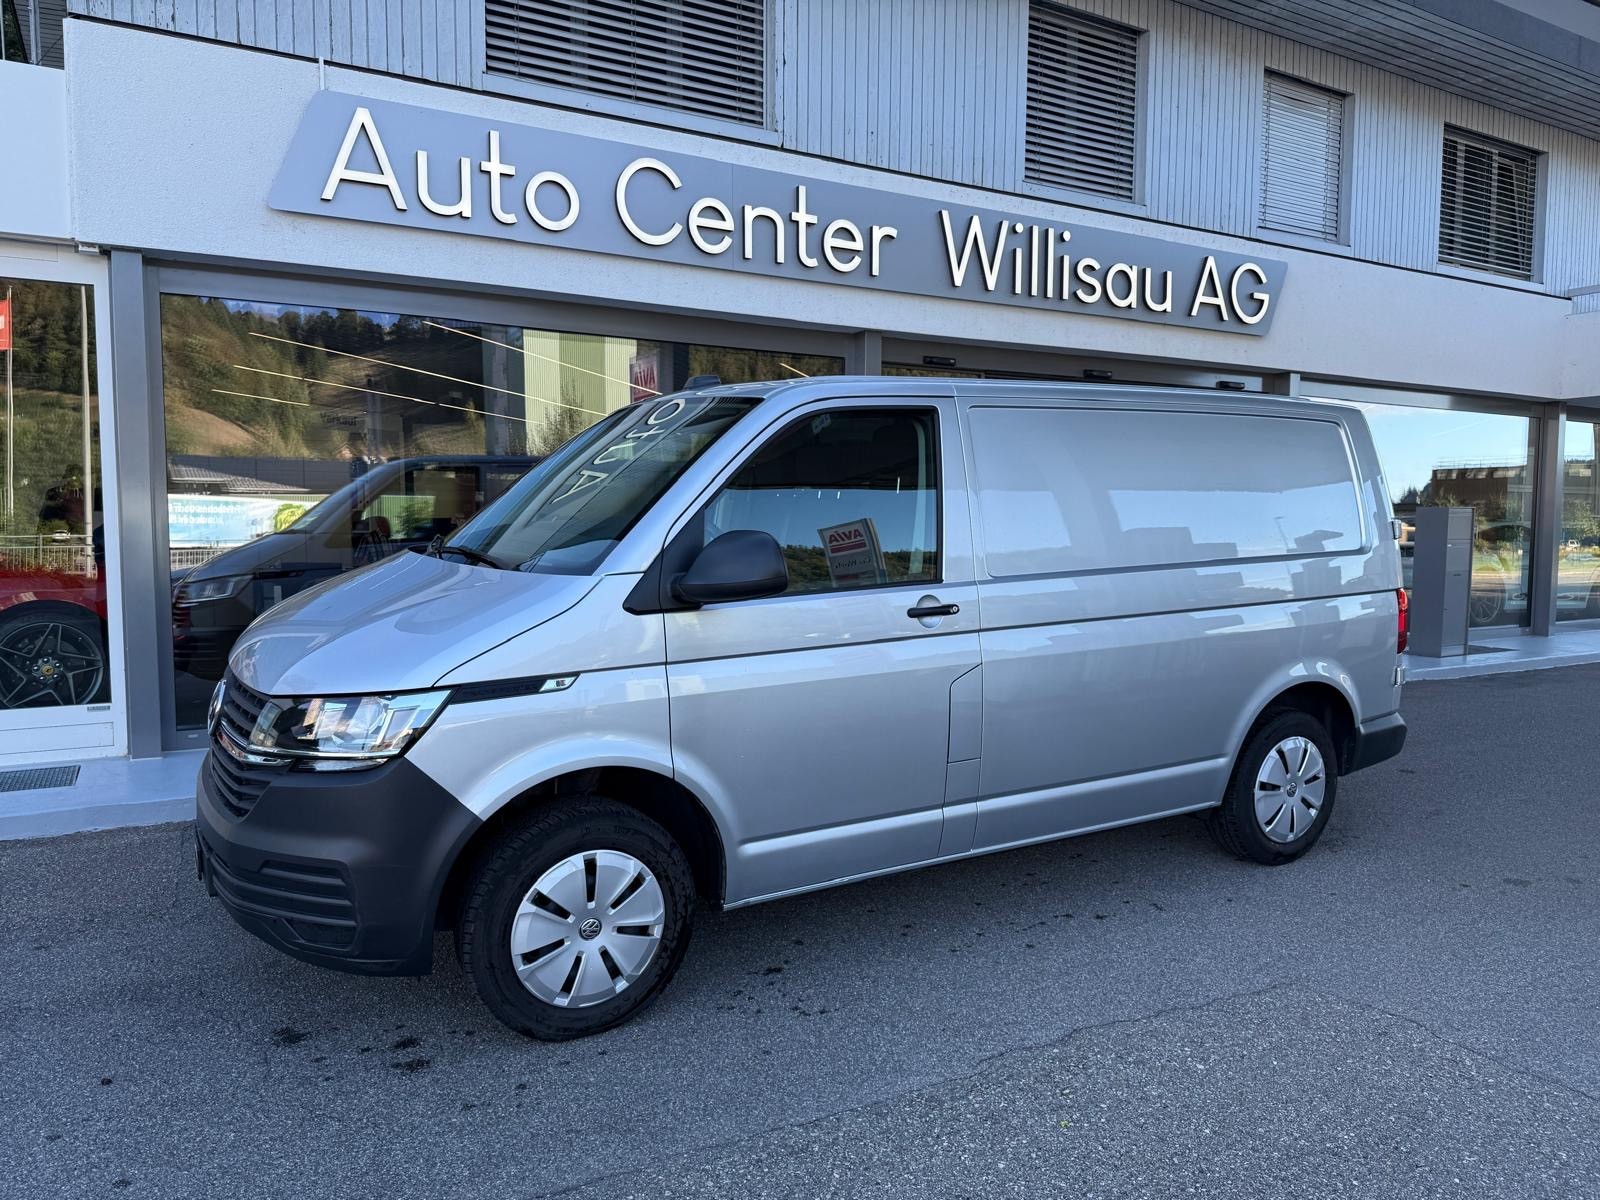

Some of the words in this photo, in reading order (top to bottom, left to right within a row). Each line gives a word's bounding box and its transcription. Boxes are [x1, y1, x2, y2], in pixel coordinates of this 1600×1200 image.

[320, 106, 580, 232] Auto
[614, 156, 898, 278] Center
[939, 208, 1174, 314] Willisau
[1189, 254, 1271, 326] AG
